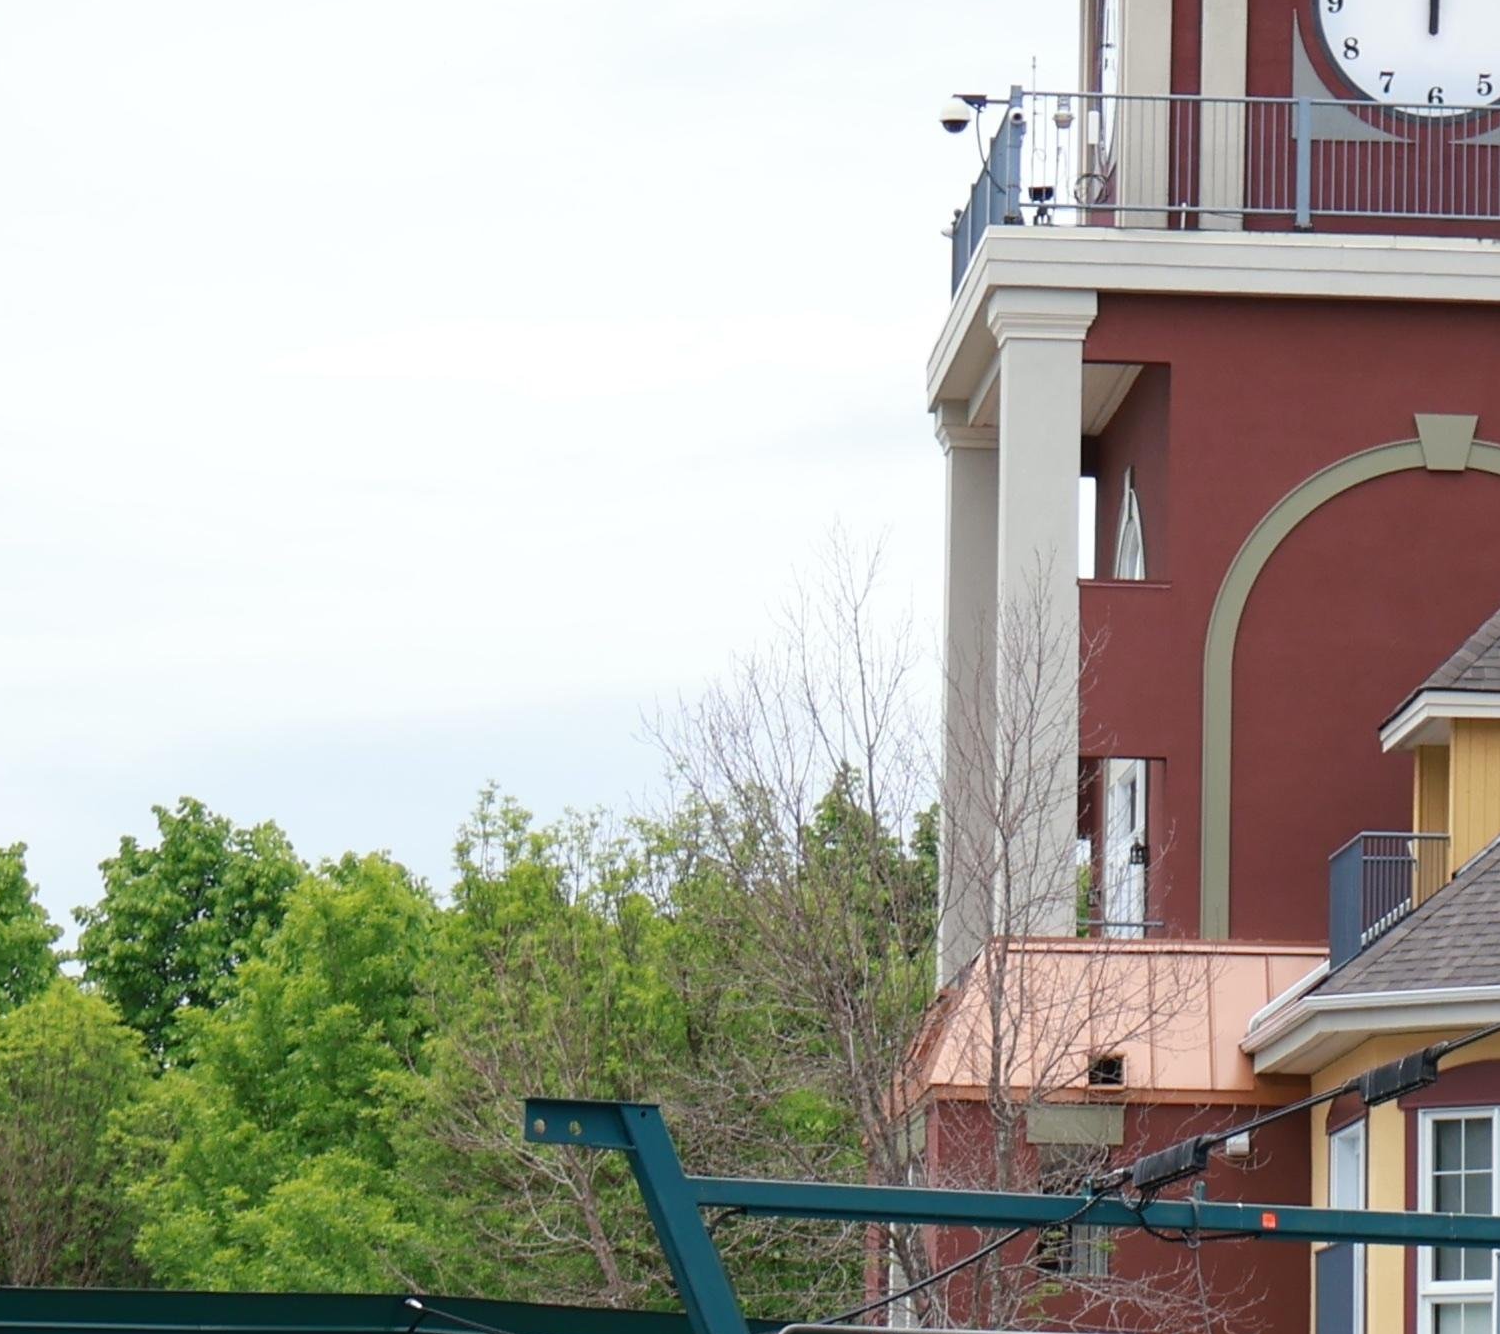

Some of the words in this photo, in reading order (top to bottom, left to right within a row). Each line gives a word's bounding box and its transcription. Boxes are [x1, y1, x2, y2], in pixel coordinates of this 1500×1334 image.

[1344, 37, 1360, 59] 8
[1380, 71, 1394, 93] 7
[1477, 74, 1492, 95] 5
